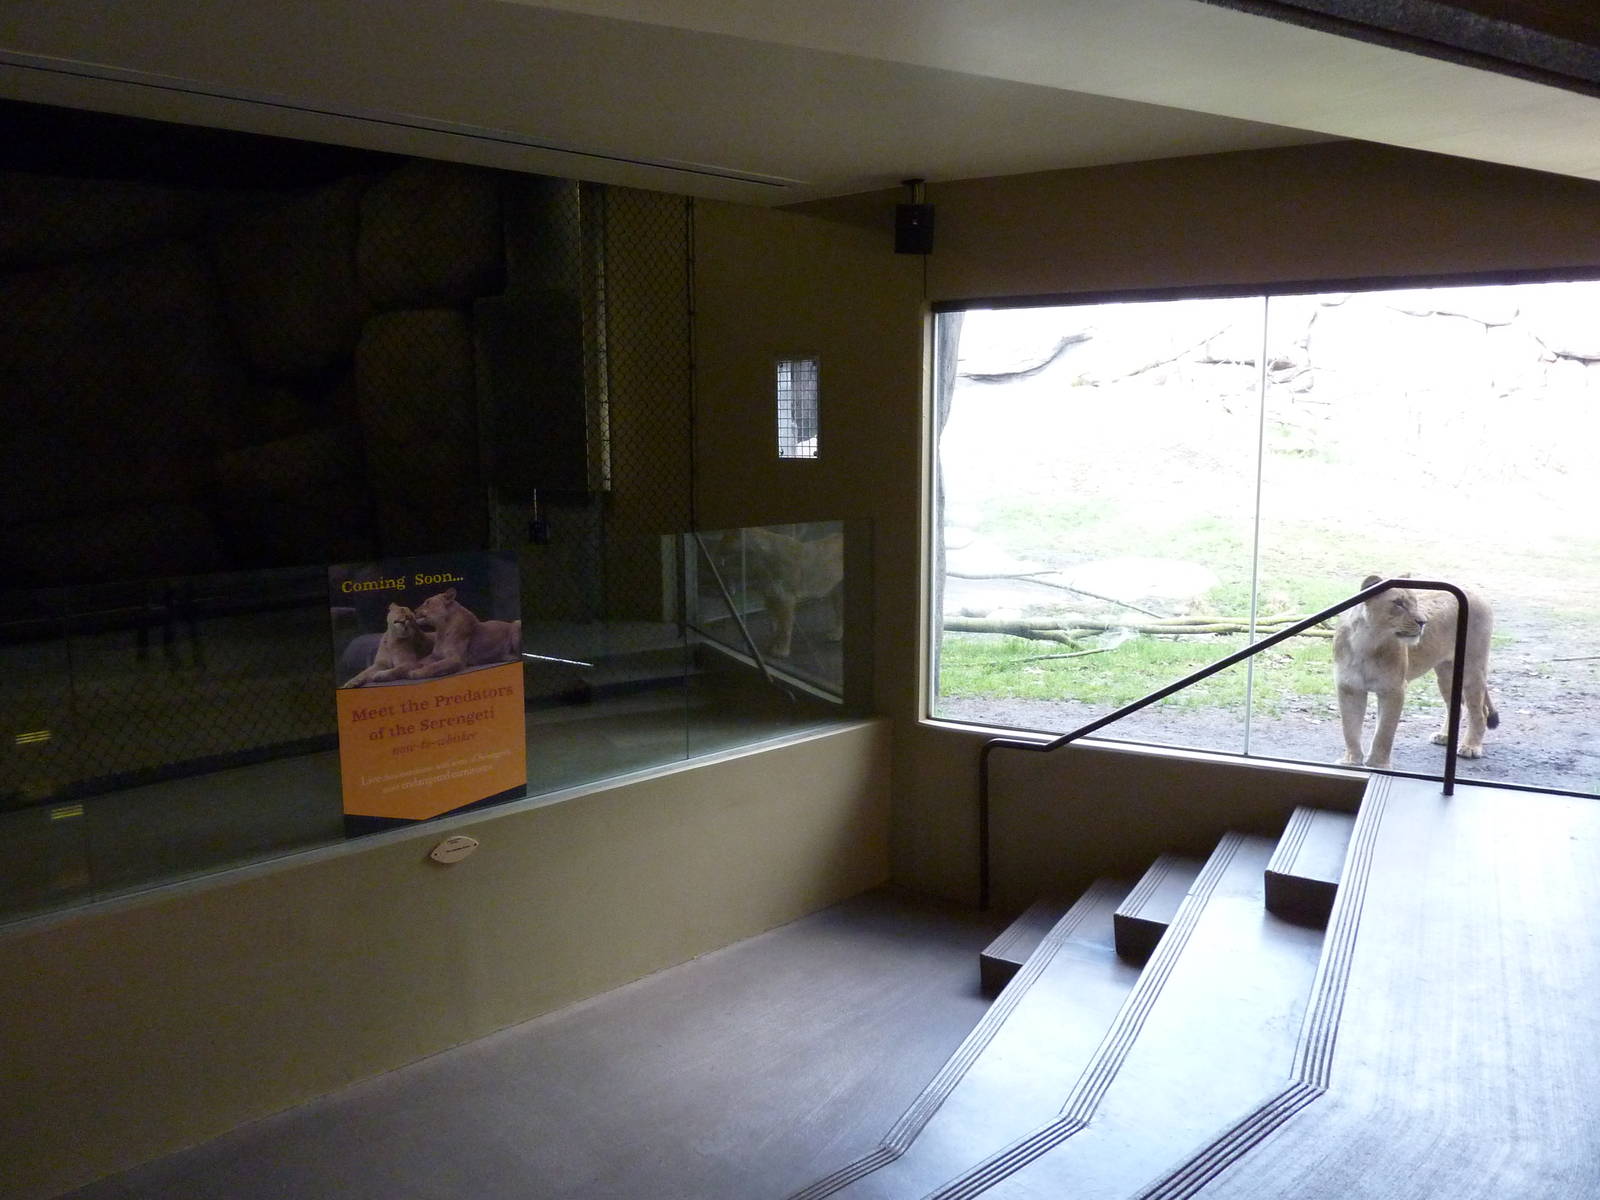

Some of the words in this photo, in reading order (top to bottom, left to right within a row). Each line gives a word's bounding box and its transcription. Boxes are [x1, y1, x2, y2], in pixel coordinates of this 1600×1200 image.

[341, 576, 406, 593] Coming
[415, 572, 464, 586] Soon...
[351, 705, 396, 722] Meet
[399, 699, 431, 714] the
[434, 685, 514, 707] Predators
[368, 727, 385, 741] of
[388, 723, 415, 738] the
[419, 705, 496, 730] Serengeti
